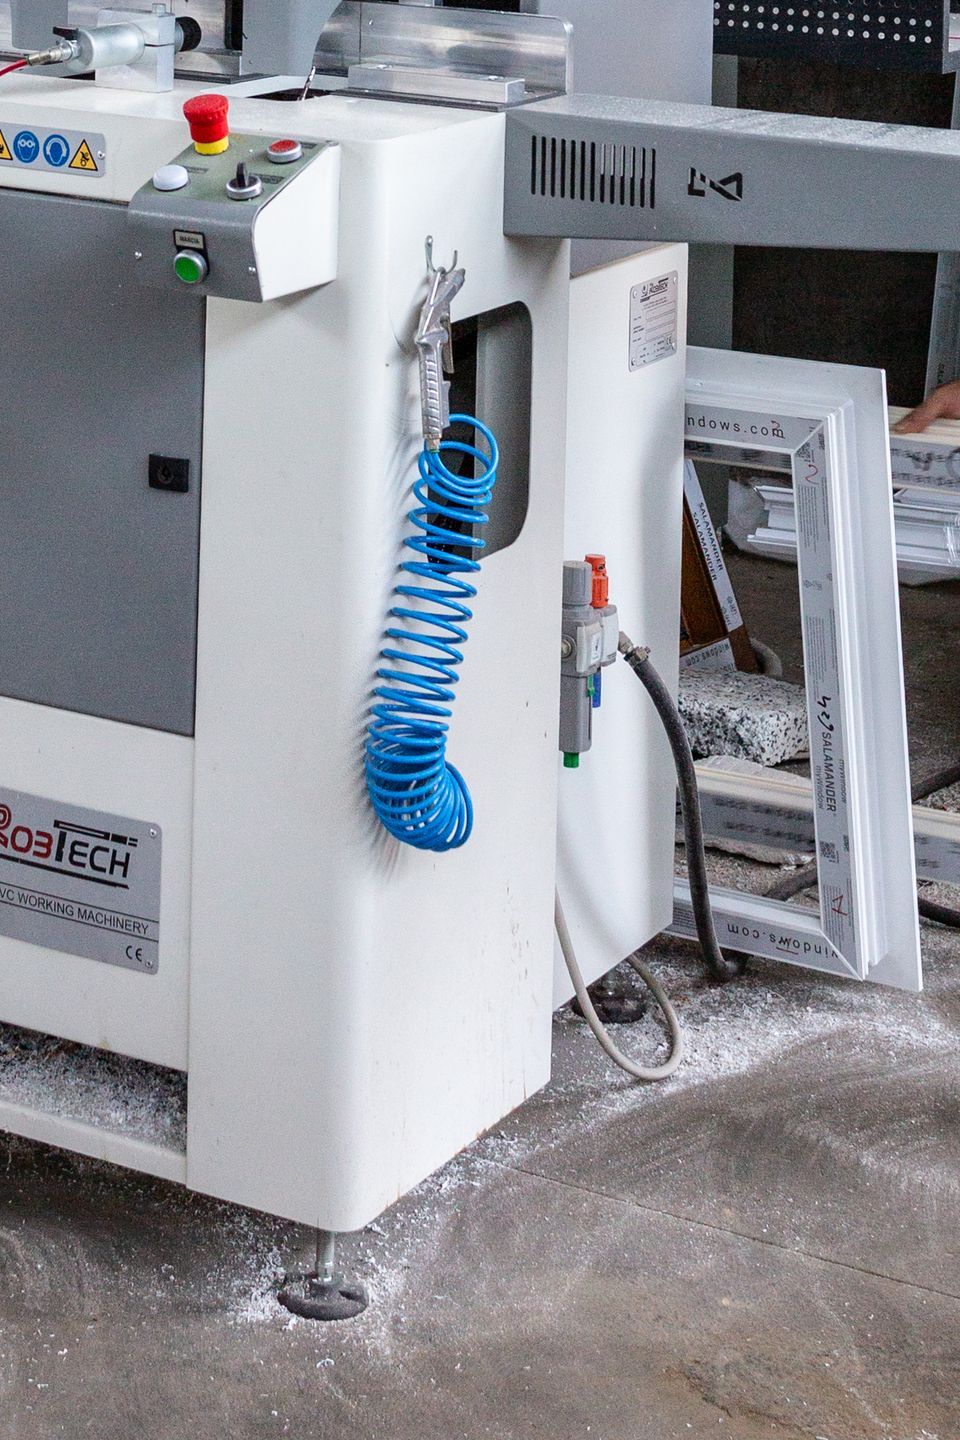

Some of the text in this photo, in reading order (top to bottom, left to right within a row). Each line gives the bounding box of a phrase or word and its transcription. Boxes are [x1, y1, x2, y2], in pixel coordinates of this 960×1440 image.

[693, 512, 717, 581] SALAMANDER
[699, 502, 723, 571] SALAMANDER
[815, 765, 825, 809] myWindow
[822, 732, 836, 812] SALAMANDER
[17, 886, 74, 917] WORKING
[77, 900, 149, 935] MACHINERY
[125, 945, 142, 962] CE
